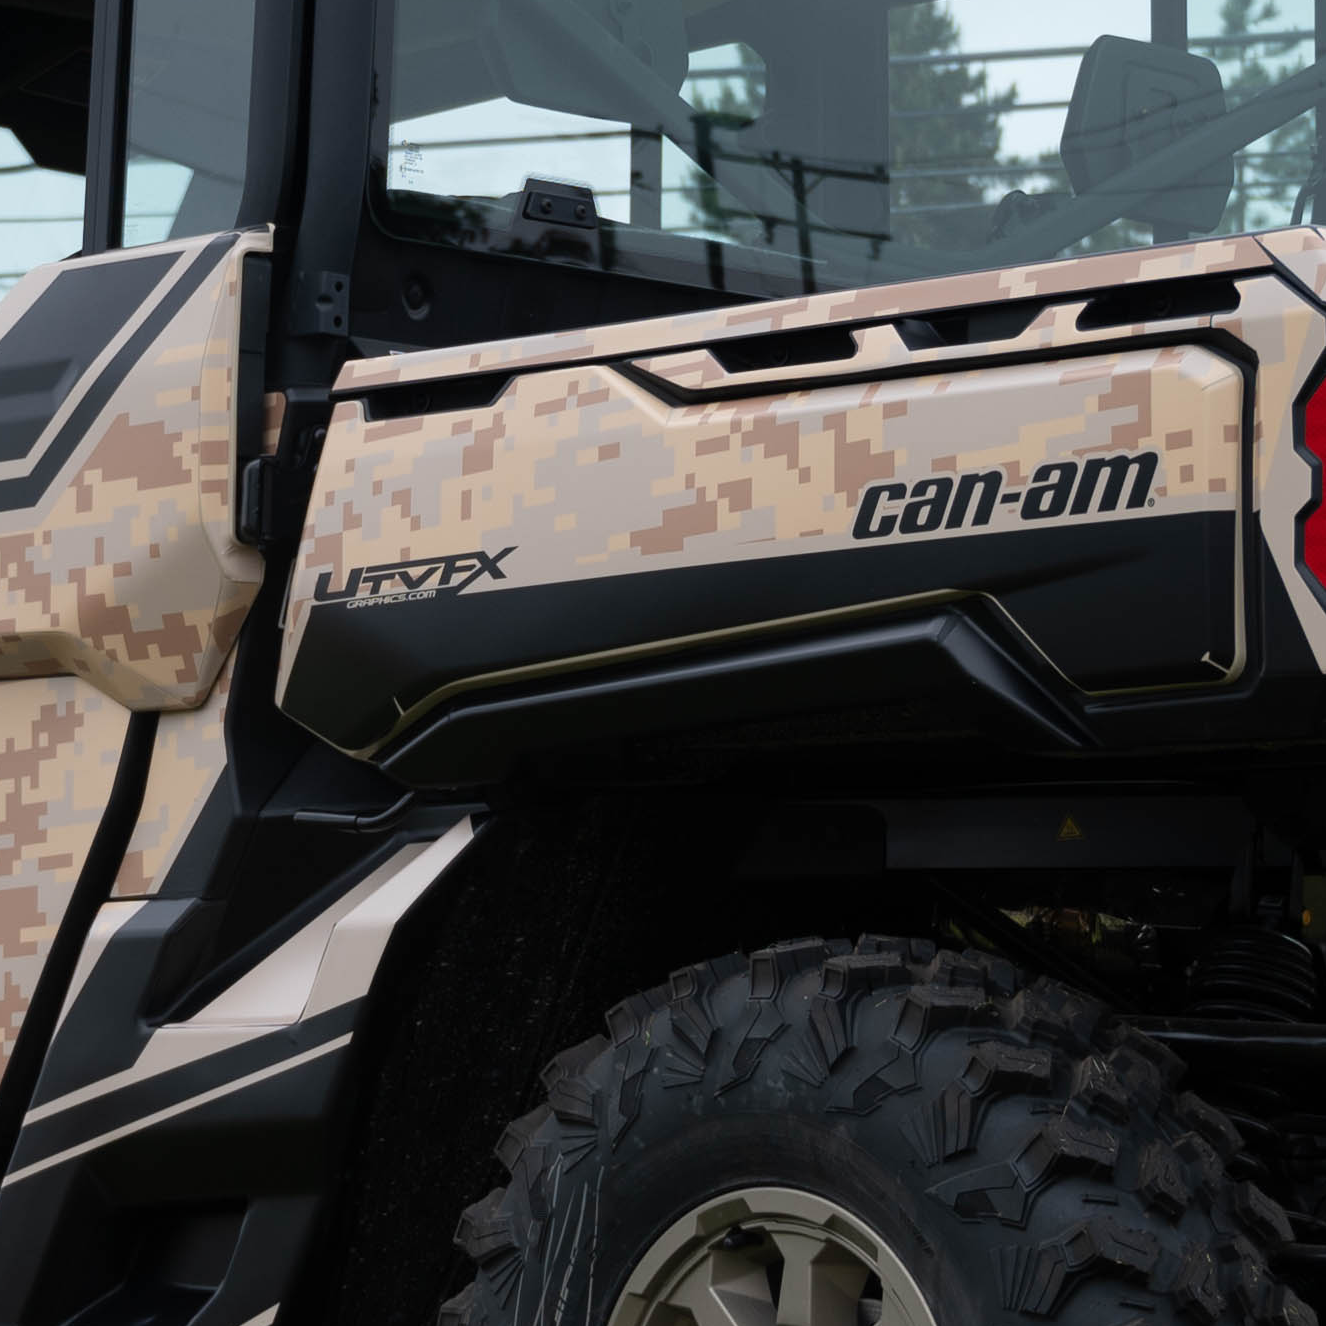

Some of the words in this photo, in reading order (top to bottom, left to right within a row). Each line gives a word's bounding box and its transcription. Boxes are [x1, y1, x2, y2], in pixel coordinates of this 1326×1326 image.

[852, 451, 1159, 540] can-am
[313, 545, 520, 603] UTVFX
[346, 588, 437, 610] GRAPHICS.COM
